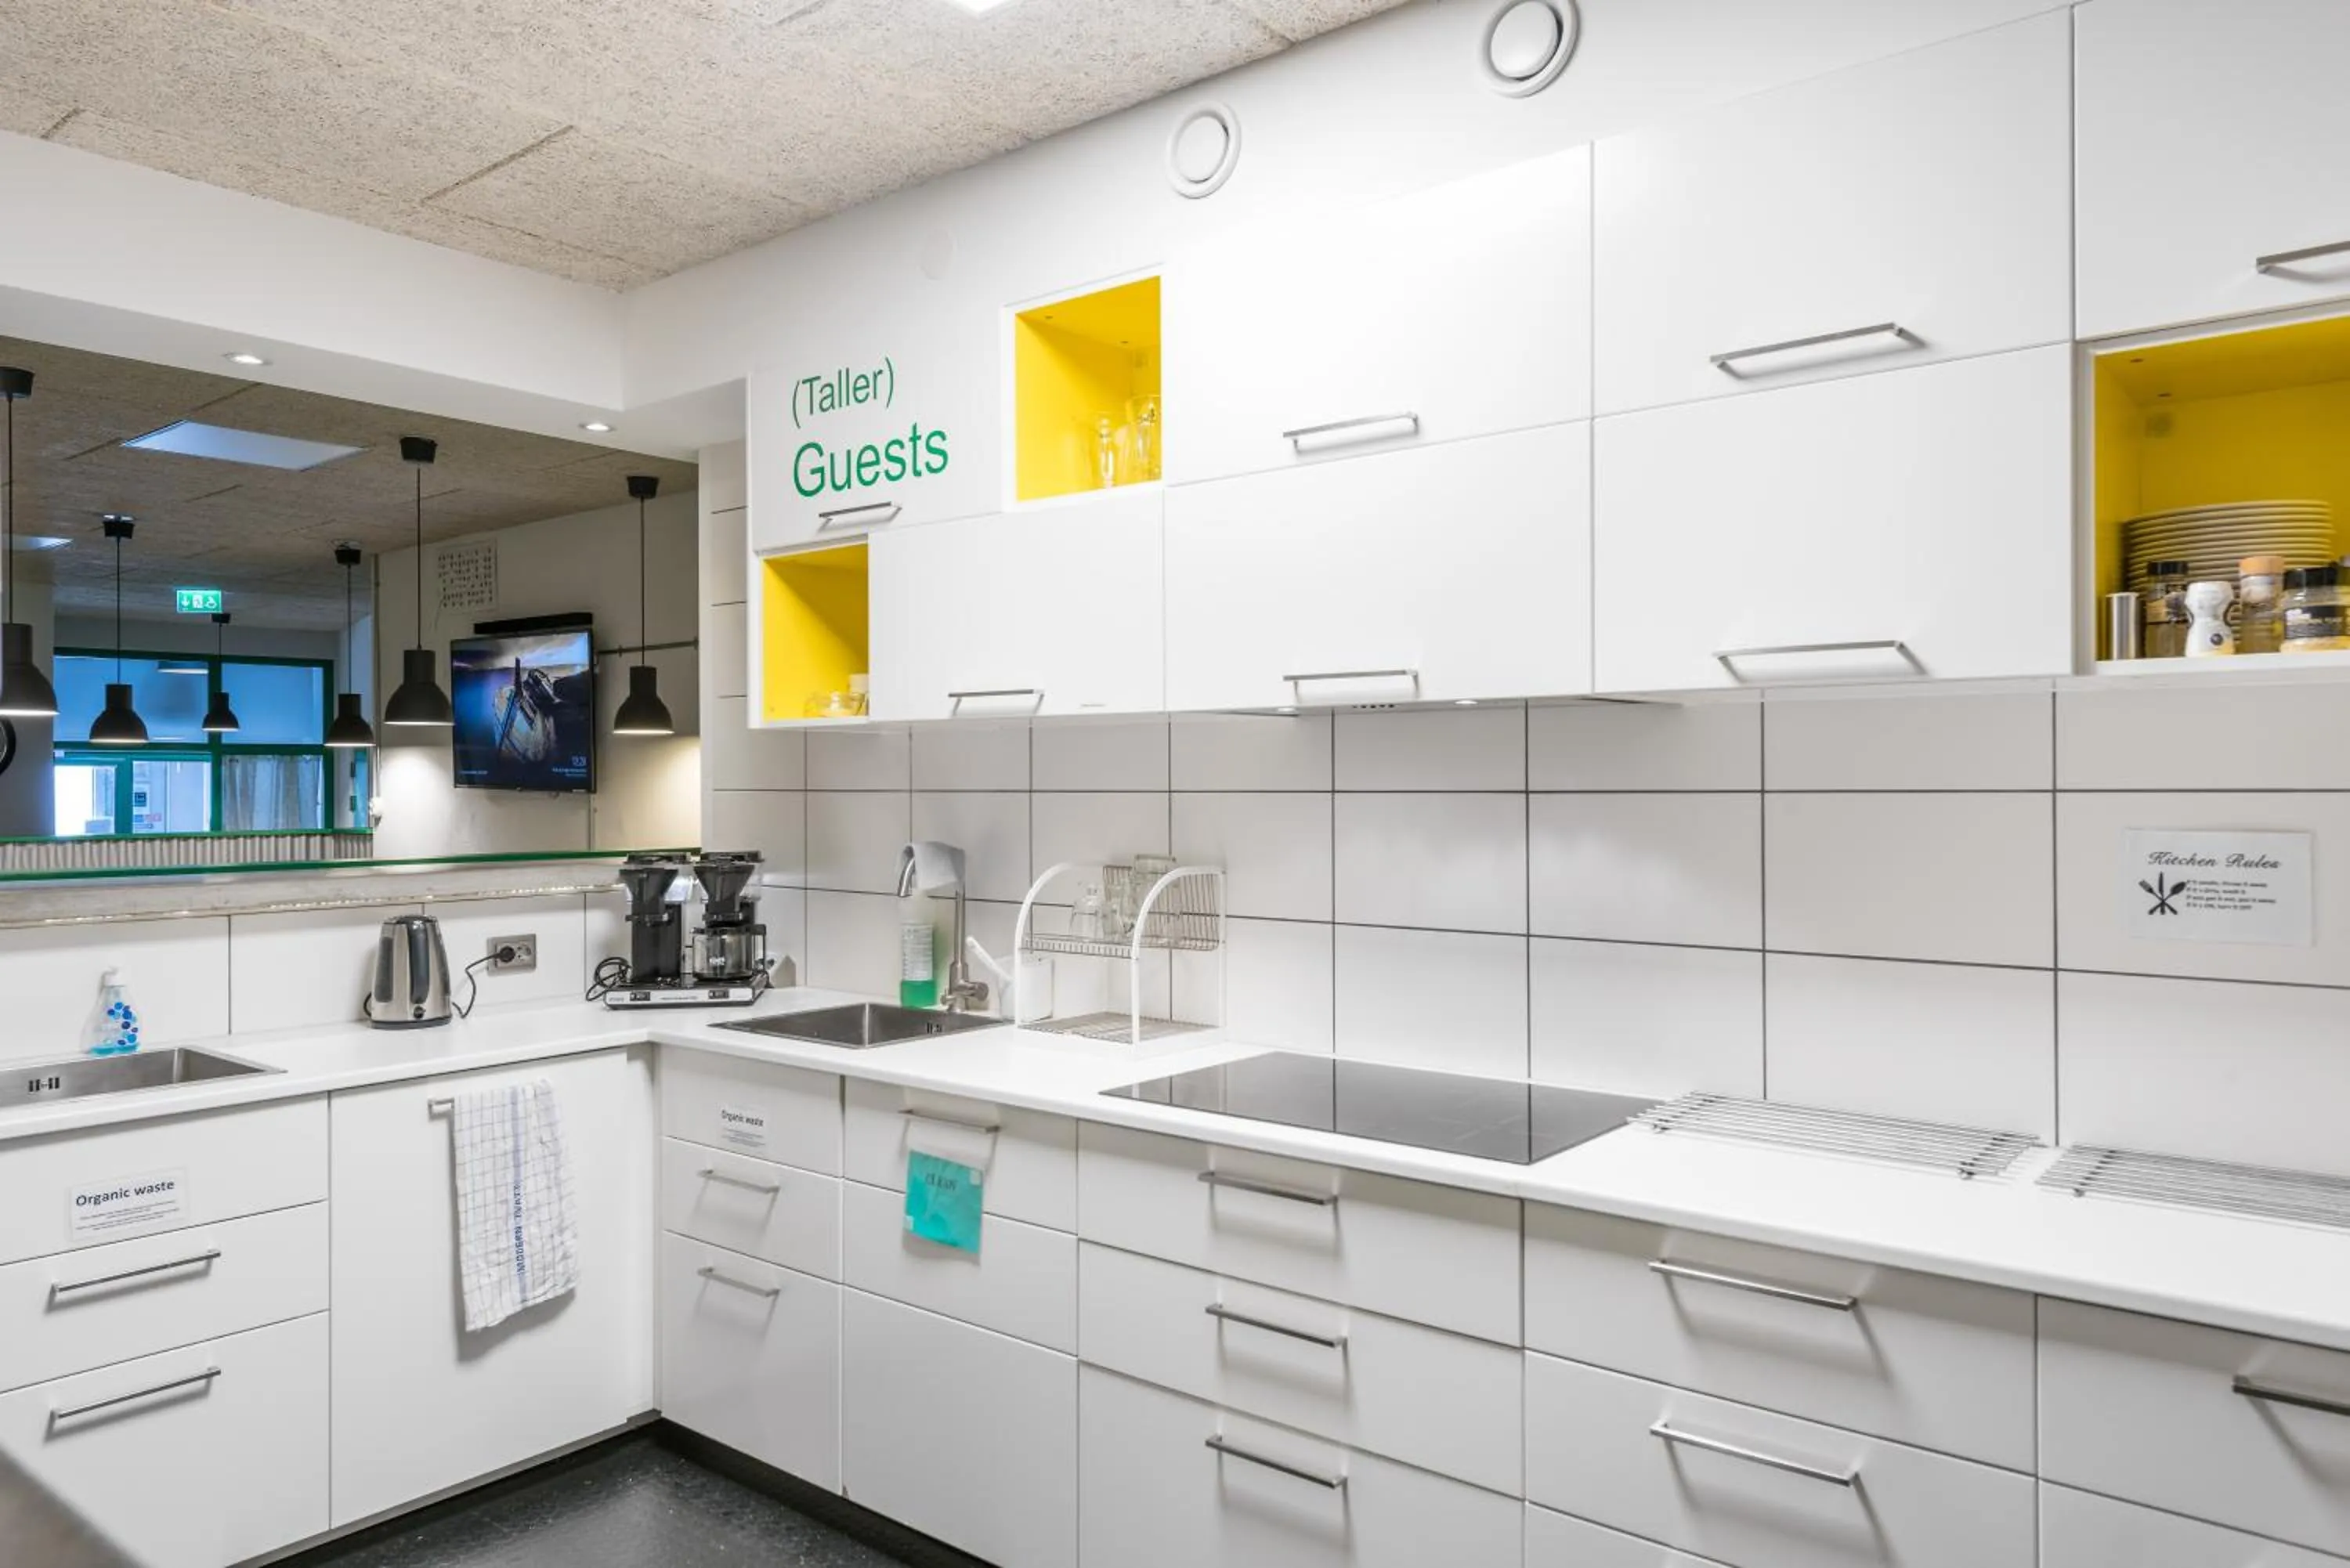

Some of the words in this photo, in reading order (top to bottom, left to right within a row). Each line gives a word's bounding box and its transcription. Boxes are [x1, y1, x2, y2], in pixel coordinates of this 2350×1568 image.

[792, 356, 895, 429] (Taller)
[794, 421, 949, 497] Guests
[2147, 851, 2217, 867] Kitchen
[2224, 852, 2280, 869] Rules
[75, 1187, 130, 1206] Organic
[134, 1180, 175, 1196] waste
